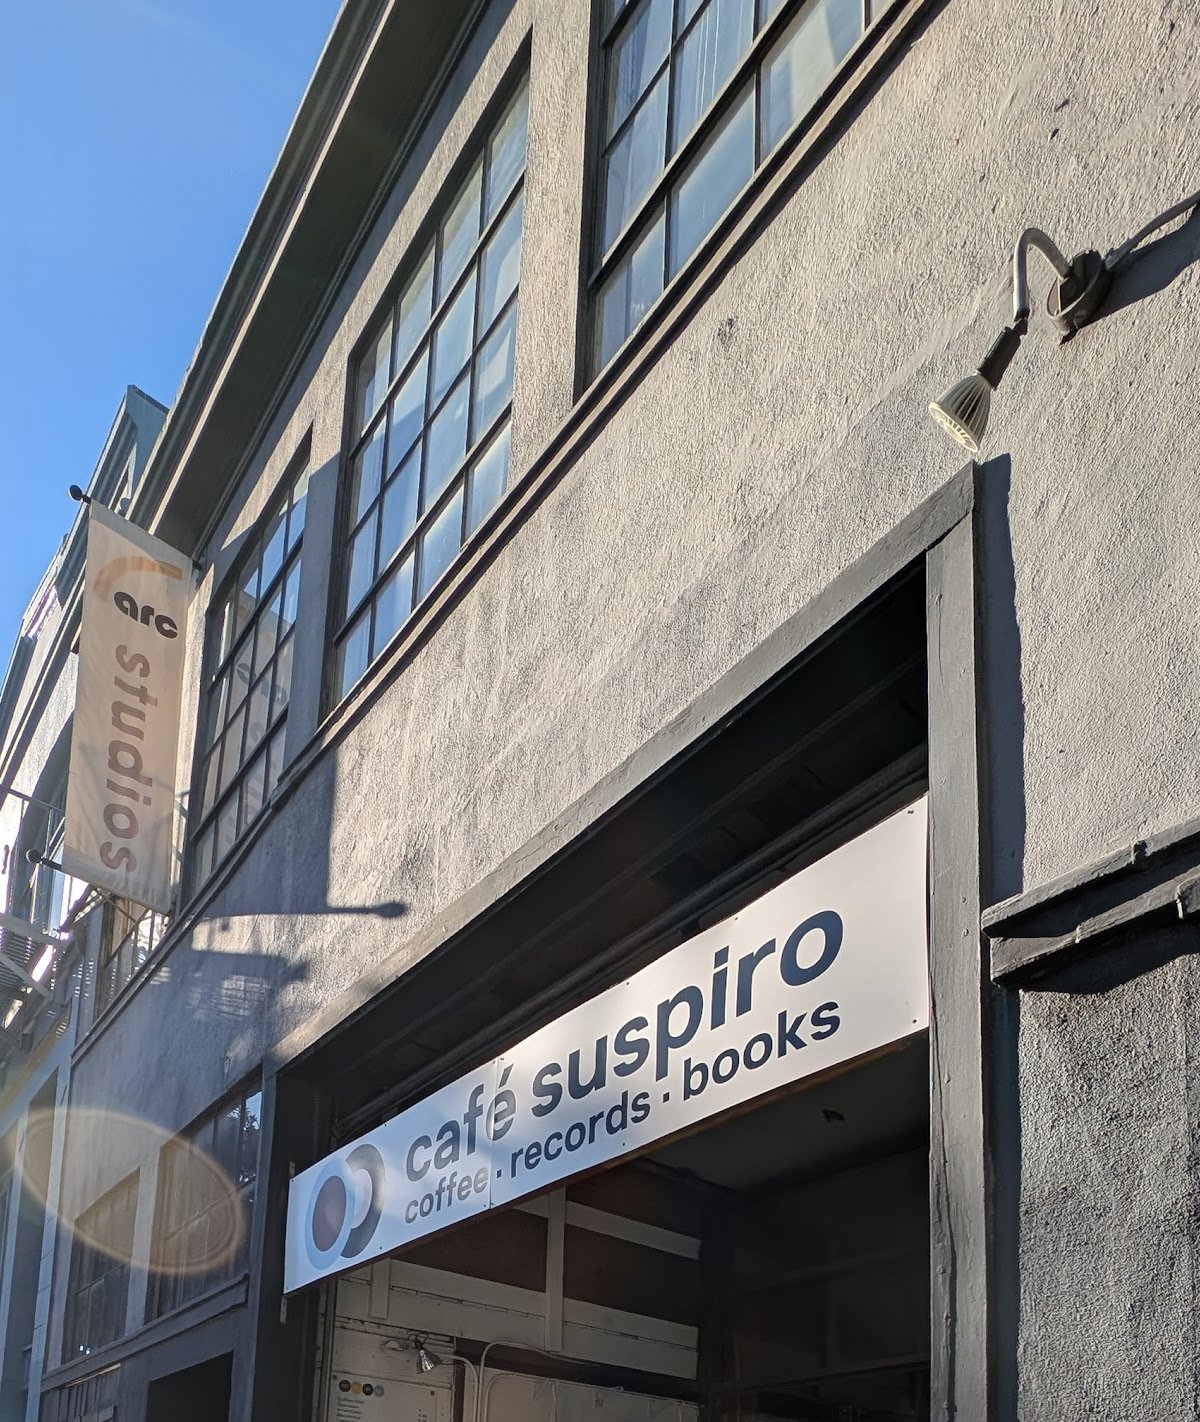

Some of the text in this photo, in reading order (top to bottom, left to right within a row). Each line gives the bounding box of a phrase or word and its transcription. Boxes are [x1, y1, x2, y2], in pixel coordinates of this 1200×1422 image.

[114, 591, 178, 639] arc
[100, 644, 160, 873] studios
[404, 1001, 841, 1224] coffee records books
[406, 910, 844, 1182] café suspiro
